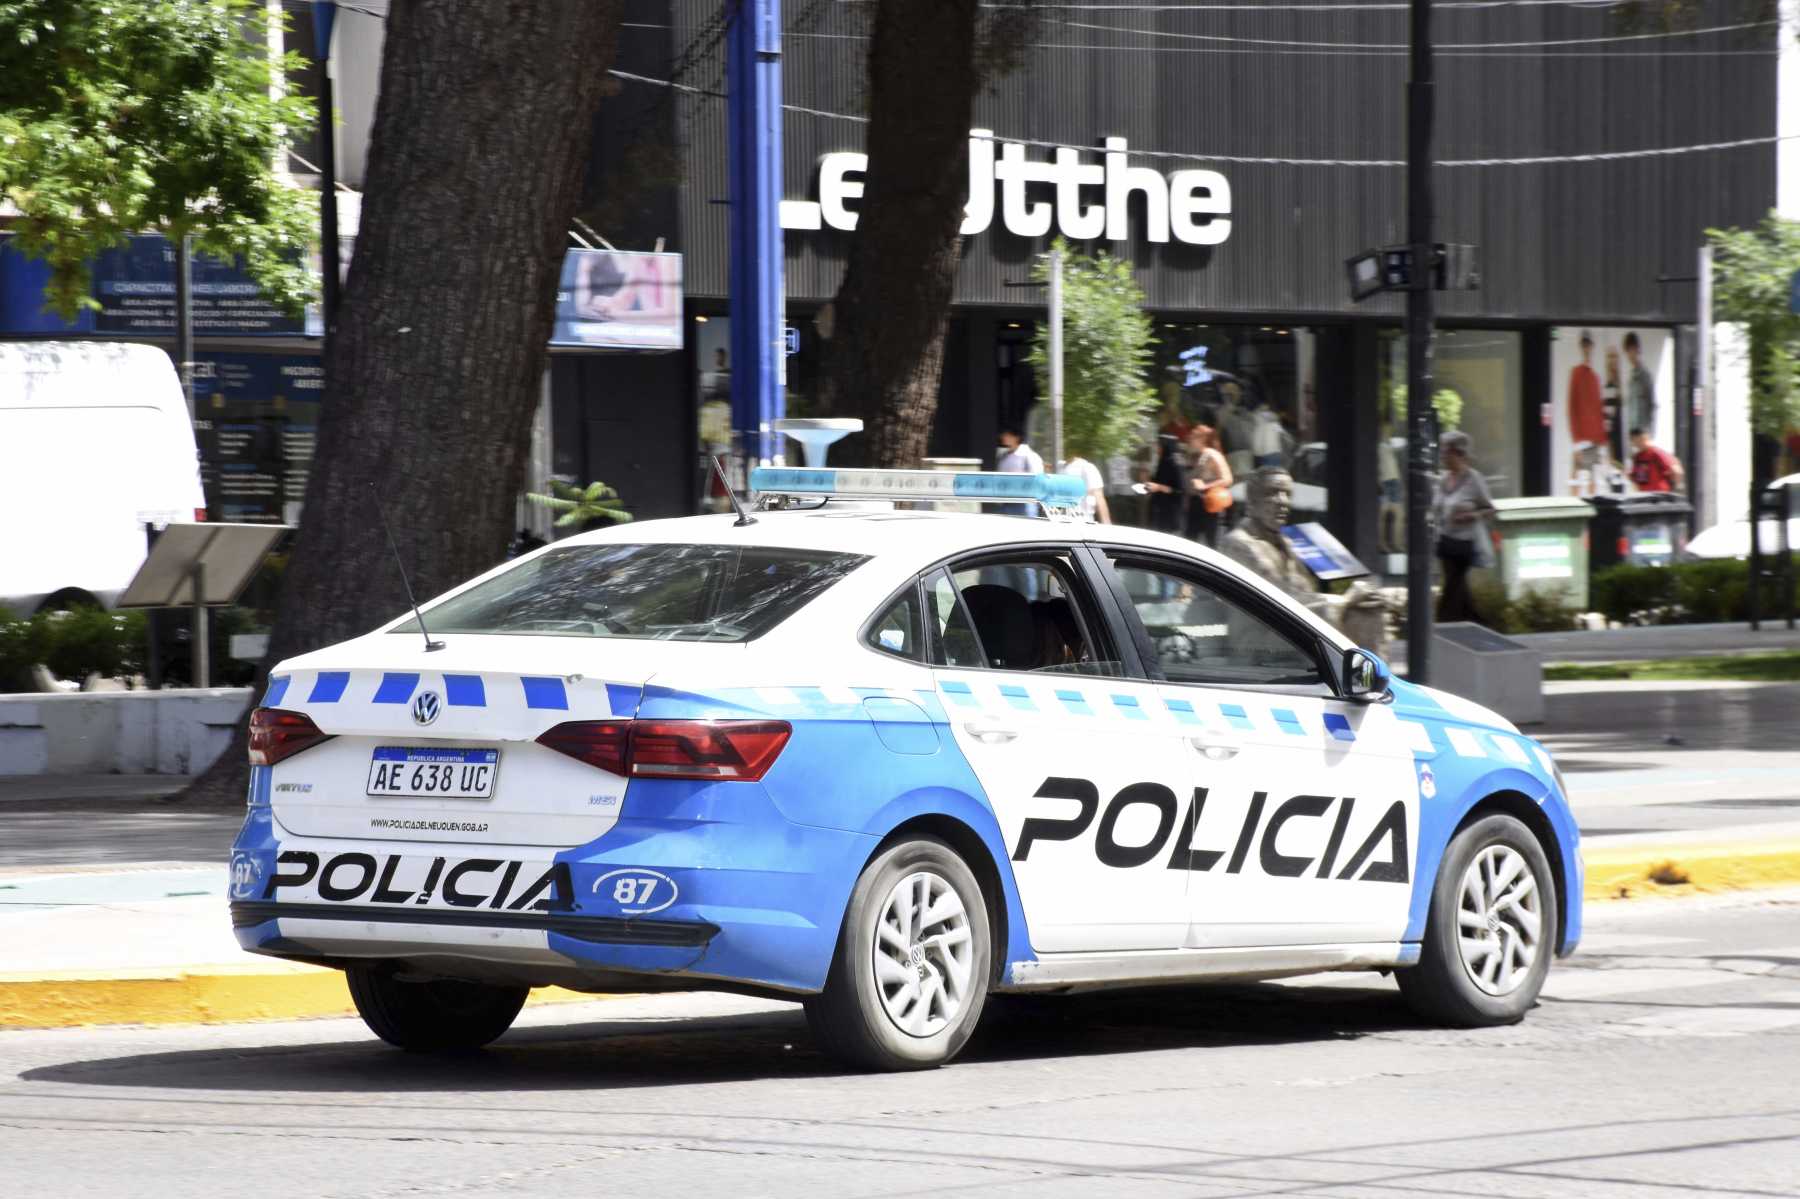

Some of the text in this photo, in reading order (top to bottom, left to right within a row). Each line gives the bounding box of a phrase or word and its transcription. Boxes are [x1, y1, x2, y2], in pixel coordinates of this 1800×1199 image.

[373, 763, 489, 792] AE 638 UC
[370, 818, 489, 833] WWW.POLICIADELNEUQUEN.GOB.AR
[1012, 776, 1410, 885] POLICIA
[263, 849, 577, 913] POLICIA
[613, 878, 658, 904] 87
